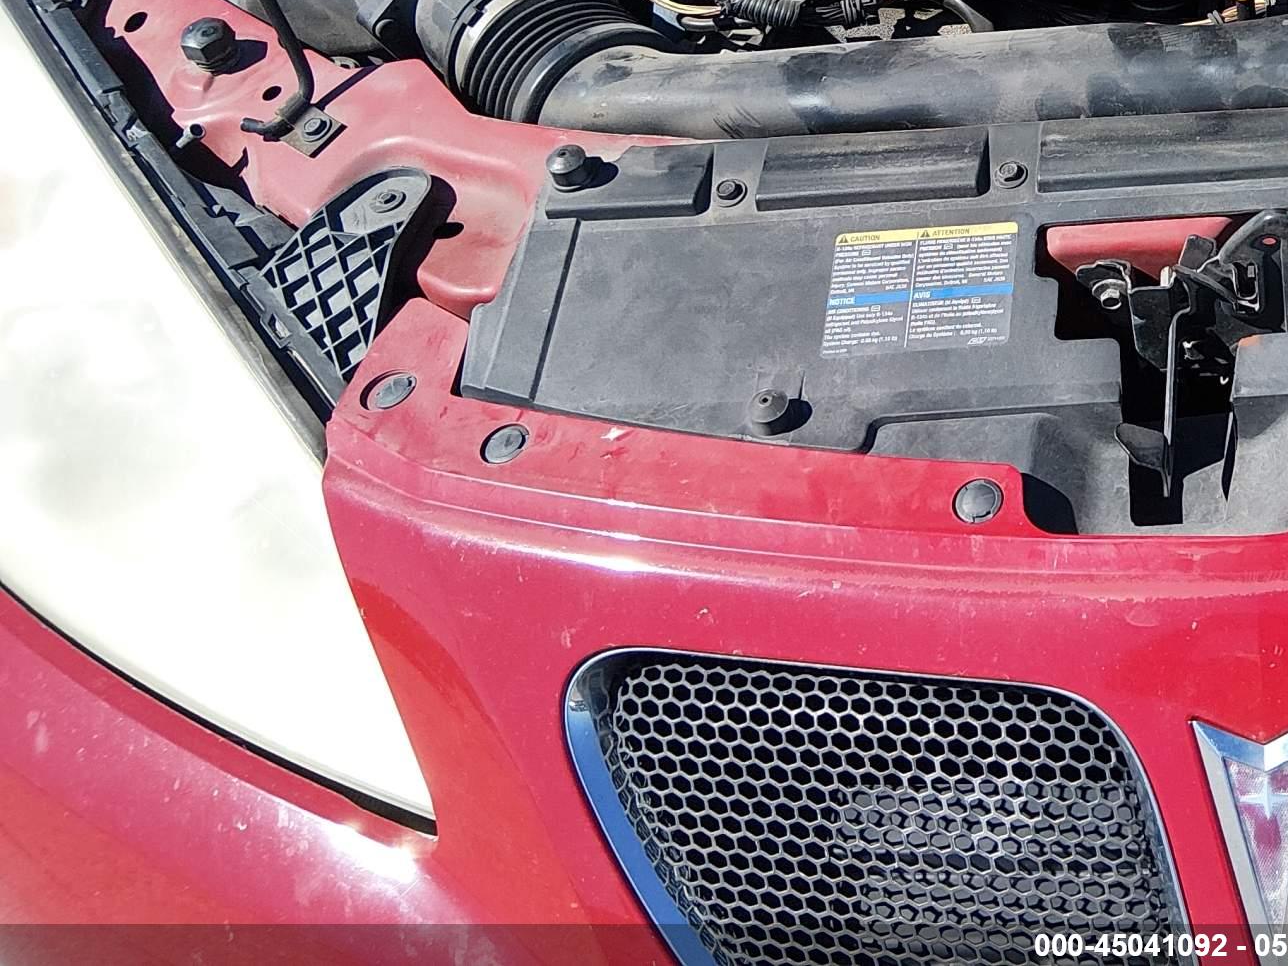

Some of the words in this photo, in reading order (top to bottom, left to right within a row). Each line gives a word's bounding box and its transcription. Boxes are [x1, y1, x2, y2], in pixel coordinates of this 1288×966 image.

[933, 228, 970, 237] ATTENTION
[850, 234, 881, 242] CAUTION
[913, 291, 931, 299] AVIS
[829, 296, 855, 306] NOTICE
